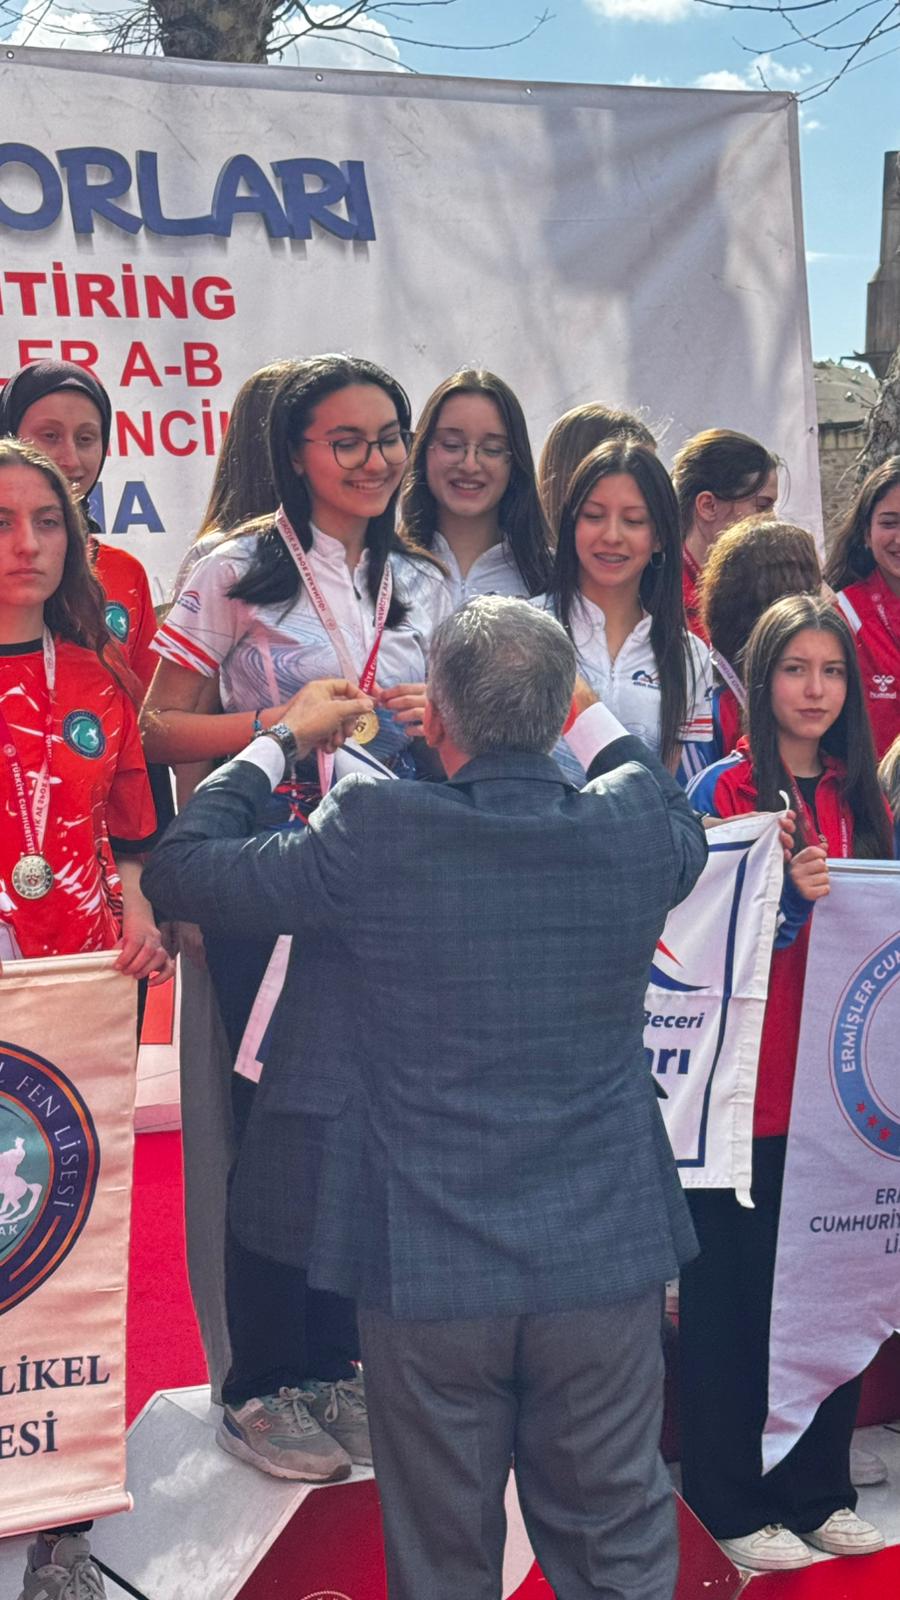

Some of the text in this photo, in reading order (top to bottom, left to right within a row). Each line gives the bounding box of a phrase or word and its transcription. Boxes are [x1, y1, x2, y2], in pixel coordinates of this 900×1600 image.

[0, 262, 236, 320] TİRİNG
[0, 340, 222, 387] ER A-B
[841, 980, 877, 1073] ERMİŞLER
[16, 1075, 81, 1208] FEN LİSESİ
